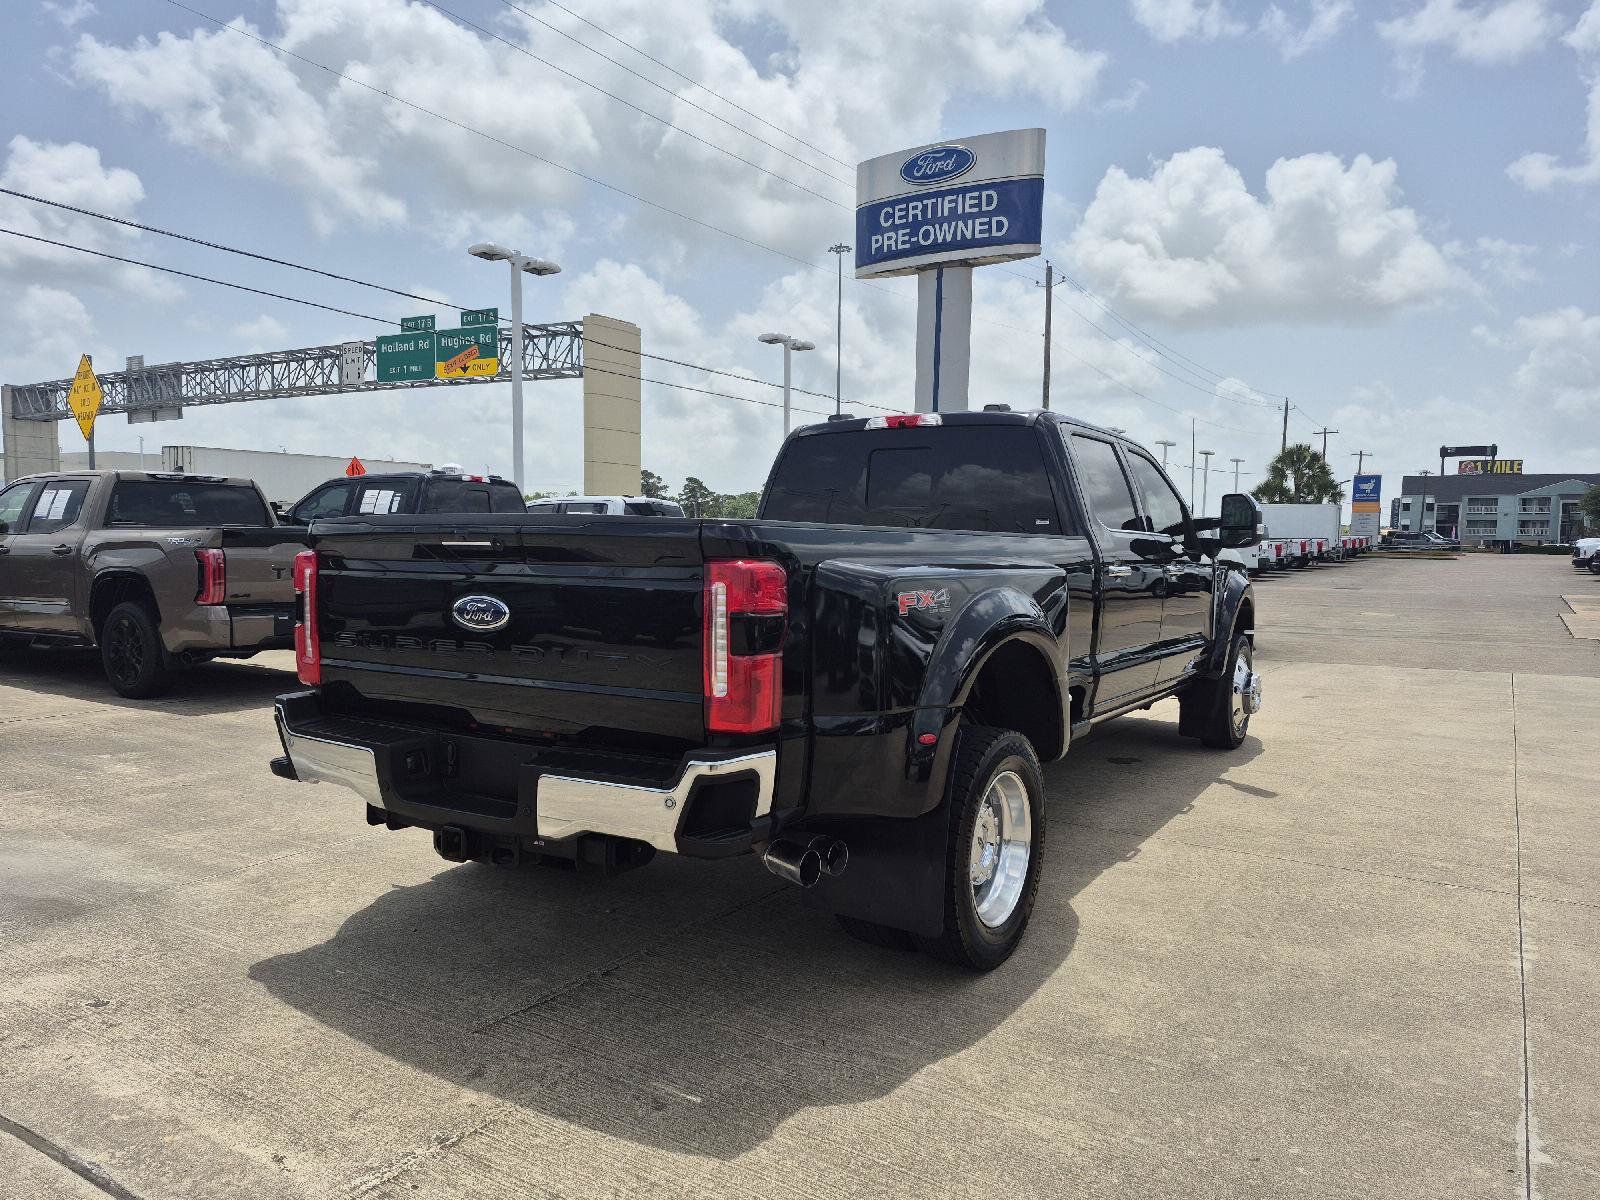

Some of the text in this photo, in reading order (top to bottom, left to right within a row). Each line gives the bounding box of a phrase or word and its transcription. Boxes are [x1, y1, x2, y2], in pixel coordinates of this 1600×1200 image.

[913, 151, 957, 178] Ford
[879, 190, 998, 228] CERTIFIED
[871, 216, 1009, 255] PRE-OWNED
[381, 340, 430, 353] Holland Rd
[441, 333, 492, 348] Hughes Rd
[472, 363, 491, 372] ONLY
[464, 602, 494, 621] Ford
[898, 588, 951, 616] FX4
